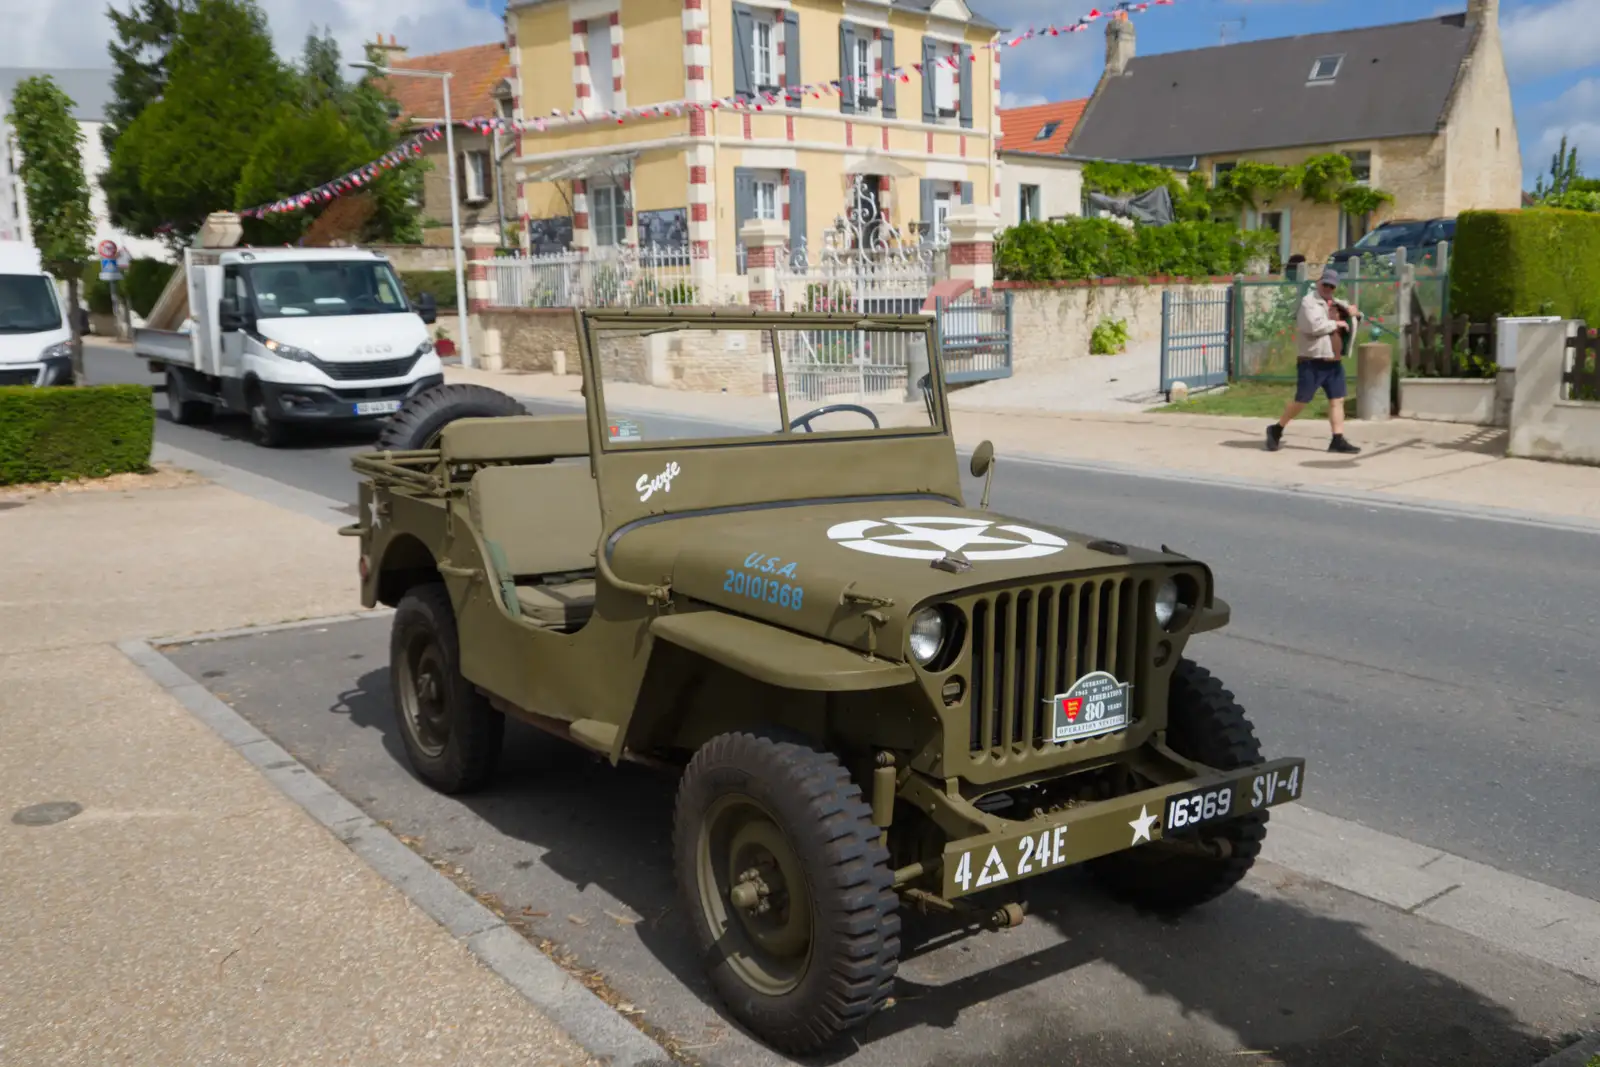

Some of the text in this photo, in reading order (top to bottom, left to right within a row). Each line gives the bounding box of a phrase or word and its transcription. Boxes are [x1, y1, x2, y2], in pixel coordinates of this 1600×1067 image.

[636, 461, 681, 502] Suzie
[744, 551, 797, 580] U.S.A.
[723, 569, 804, 611] 20101368
[1085, 701, 1105, 721] 80
[1089, 689, 1123, 702] LIBERATION
[1168, 765, 1299, 829] 16369 SV-4
[954, 825, 1068, 891] 4 24E
